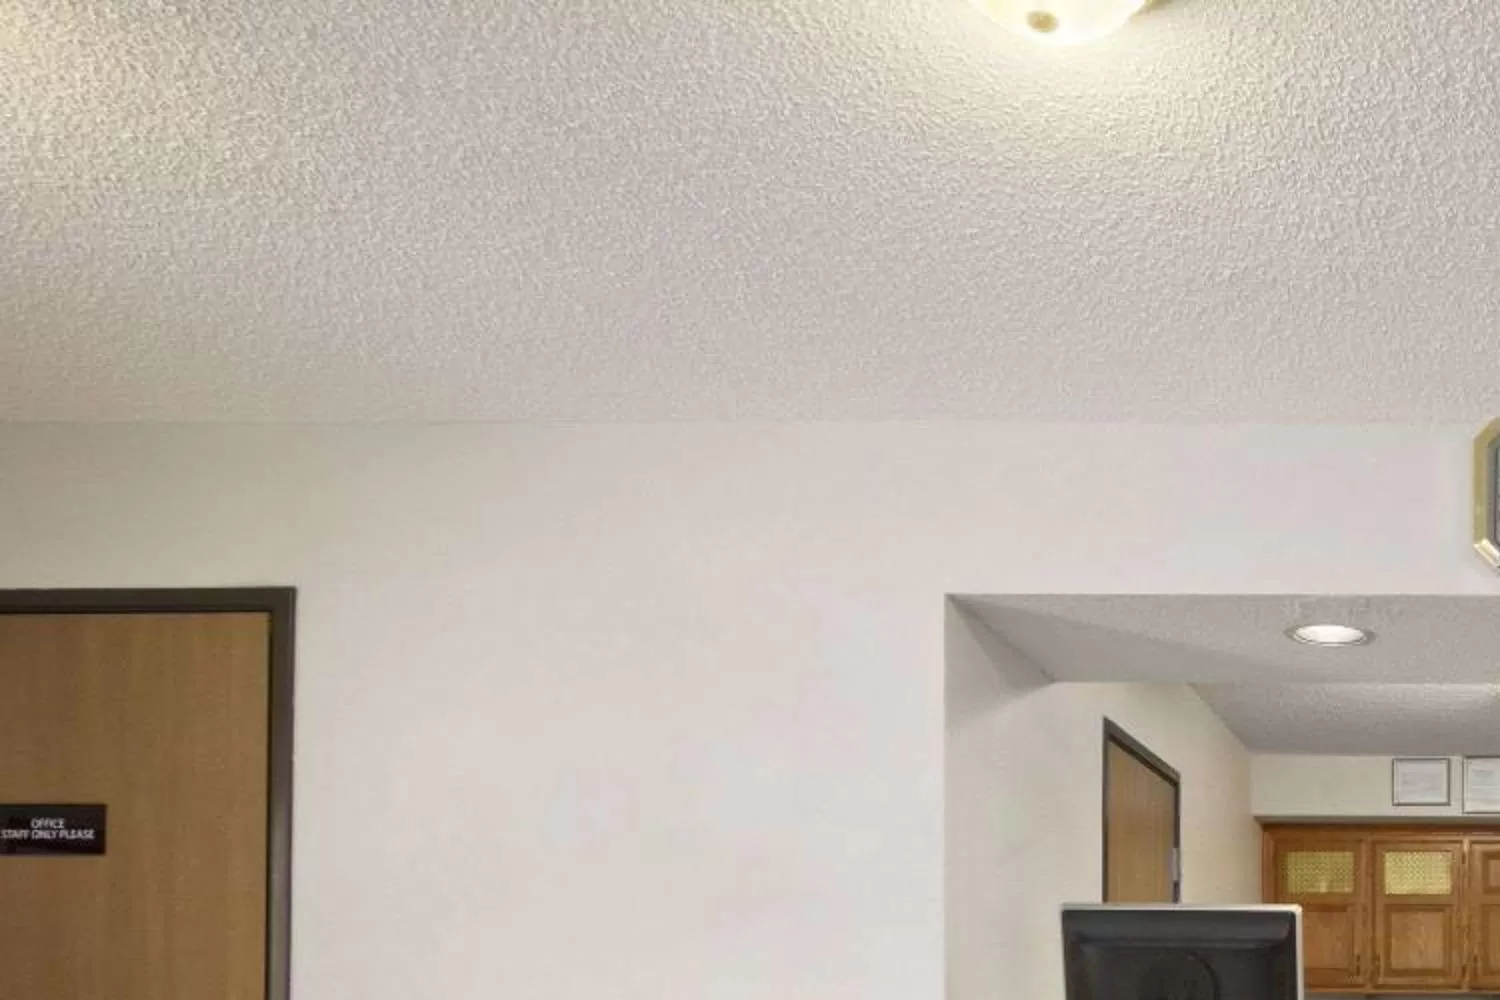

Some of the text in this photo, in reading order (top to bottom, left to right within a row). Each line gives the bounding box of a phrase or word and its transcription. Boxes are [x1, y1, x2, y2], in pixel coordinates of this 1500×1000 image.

[31, 818, 65, 829] OFFICE
[1, 829, 95, 840] STAFF ONLY PLEASE
